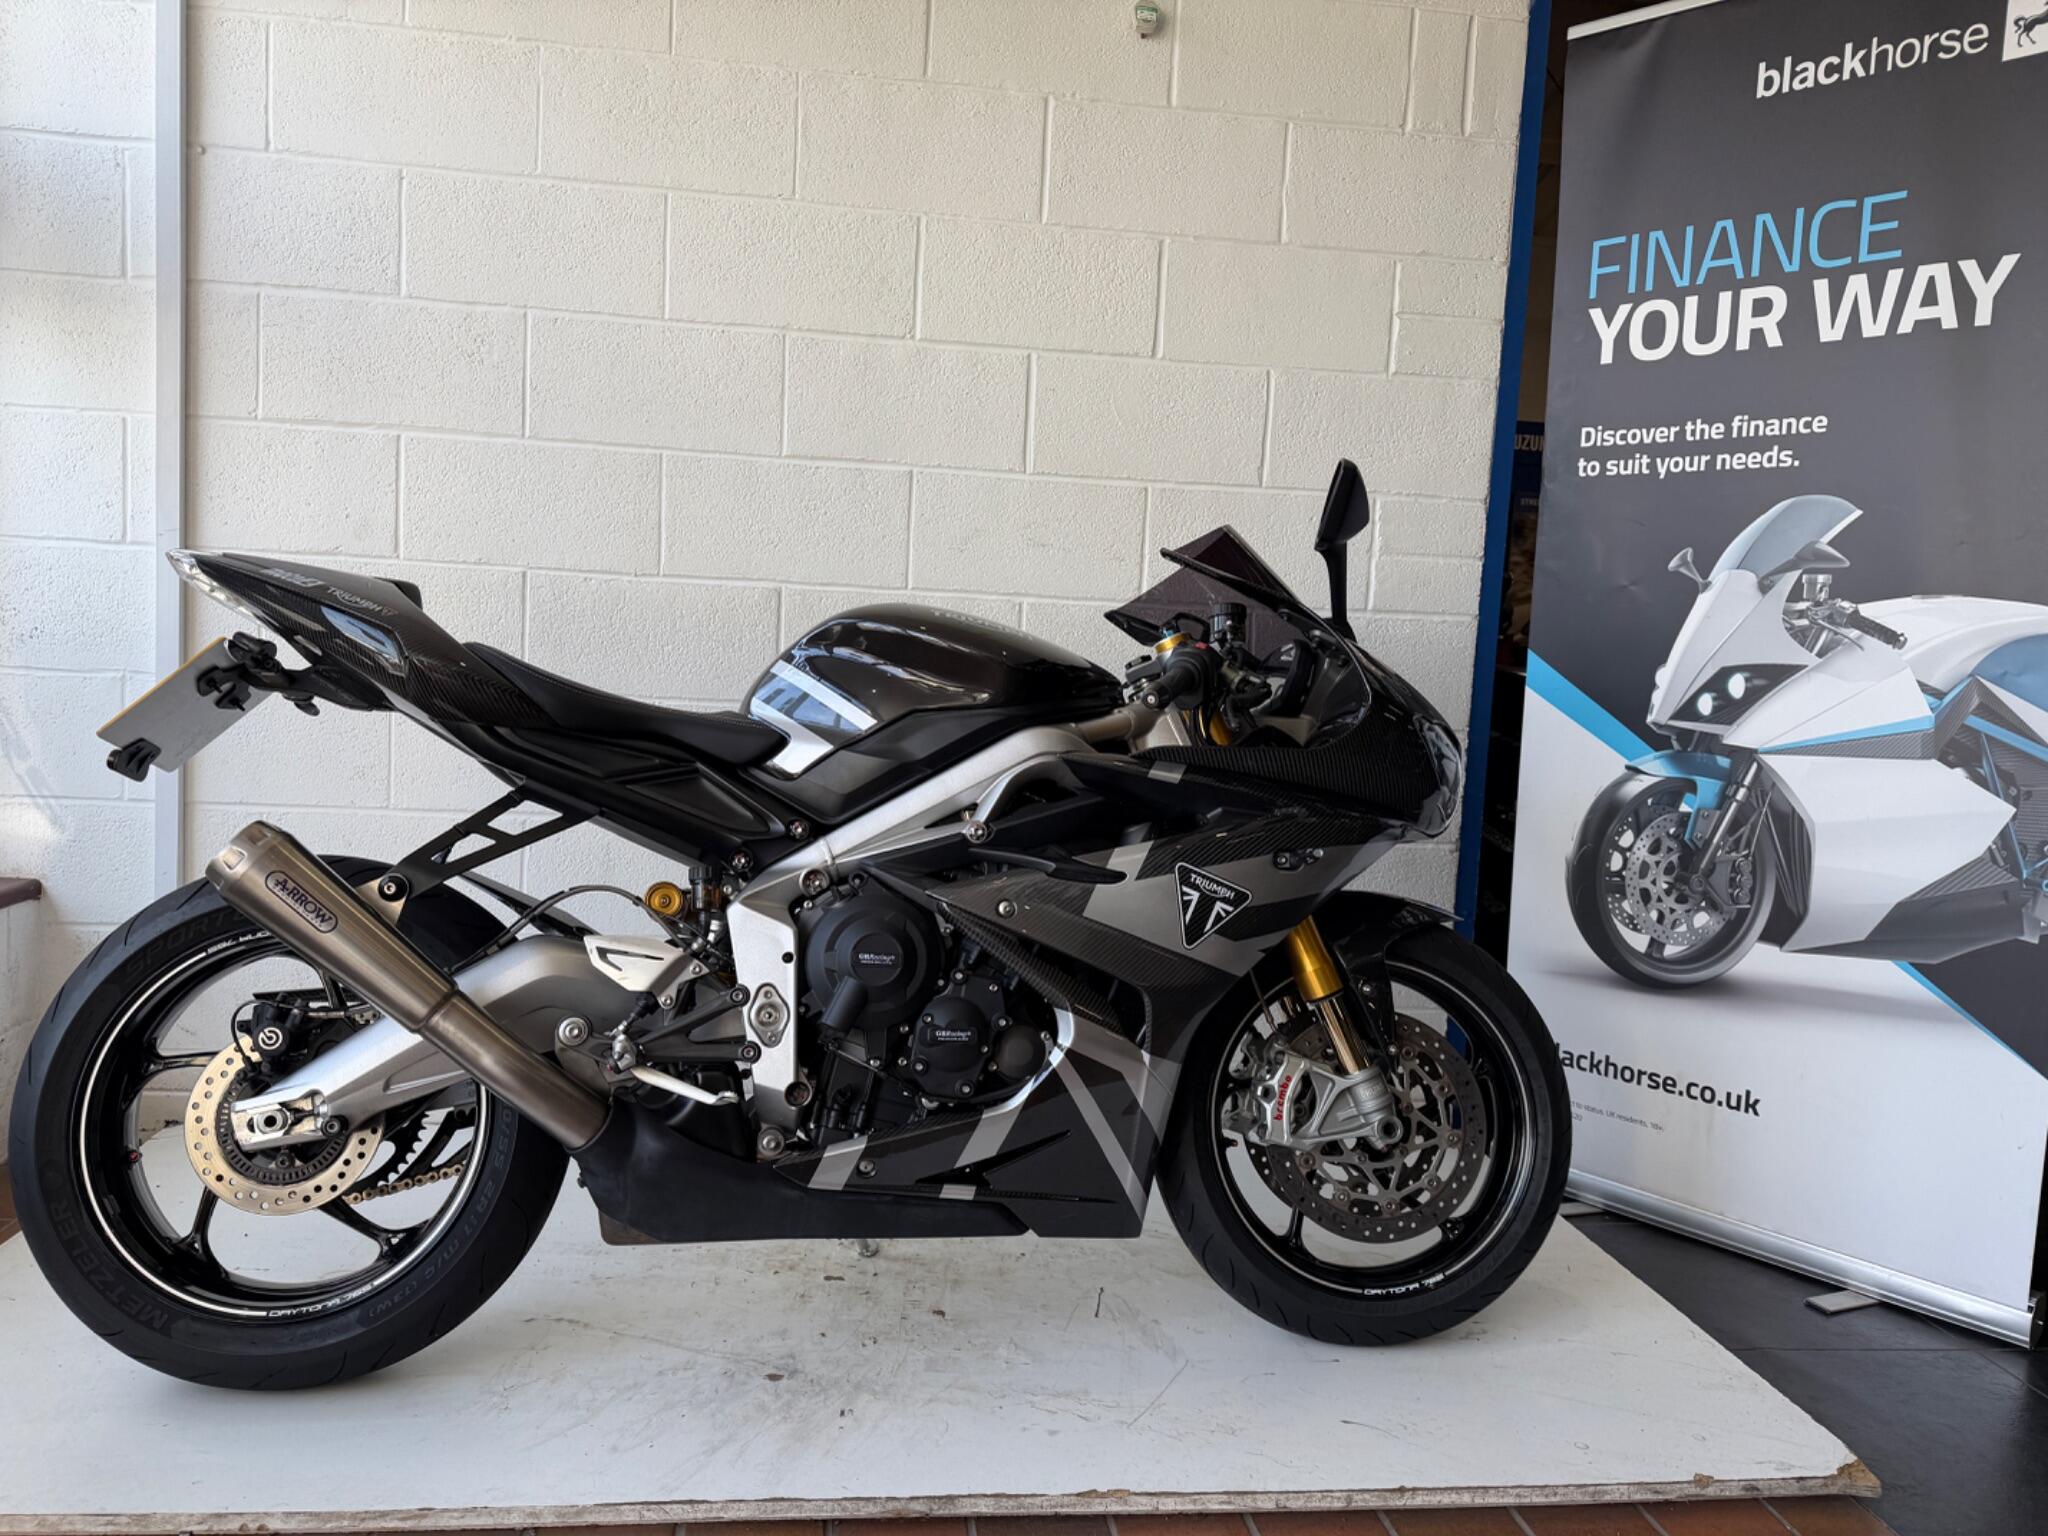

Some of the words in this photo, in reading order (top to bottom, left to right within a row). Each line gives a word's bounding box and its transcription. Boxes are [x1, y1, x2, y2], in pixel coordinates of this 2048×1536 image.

[1756, 23, 1990, 100] blackhorse
[1588, 190, 1909, 300] FINANCE
[1588, 285, 1788, 366] YOUR
[1812, 253, 2022, 343] WAY
[1514, 433, 1545, 452] UZU
[1580, 426, 1681, 448] Discover
[1684, 418, 1726, 442] the
[1730, 414, 1829, 439] finance
[1577, 457, 1601, 478] to
[1605, 453, 1651, 476] suit
[1655, 455, 1711, 480] your
[1715, 444, 1801, 471] needs.
[274, 878, 334, 924] ARROW
[1191, 873, 1236, 900] TRIUMPH
[1273, 1075, 1292, 1121] brembo
[1556, 1042, 1761, 1117] lackhorse.co.uk
